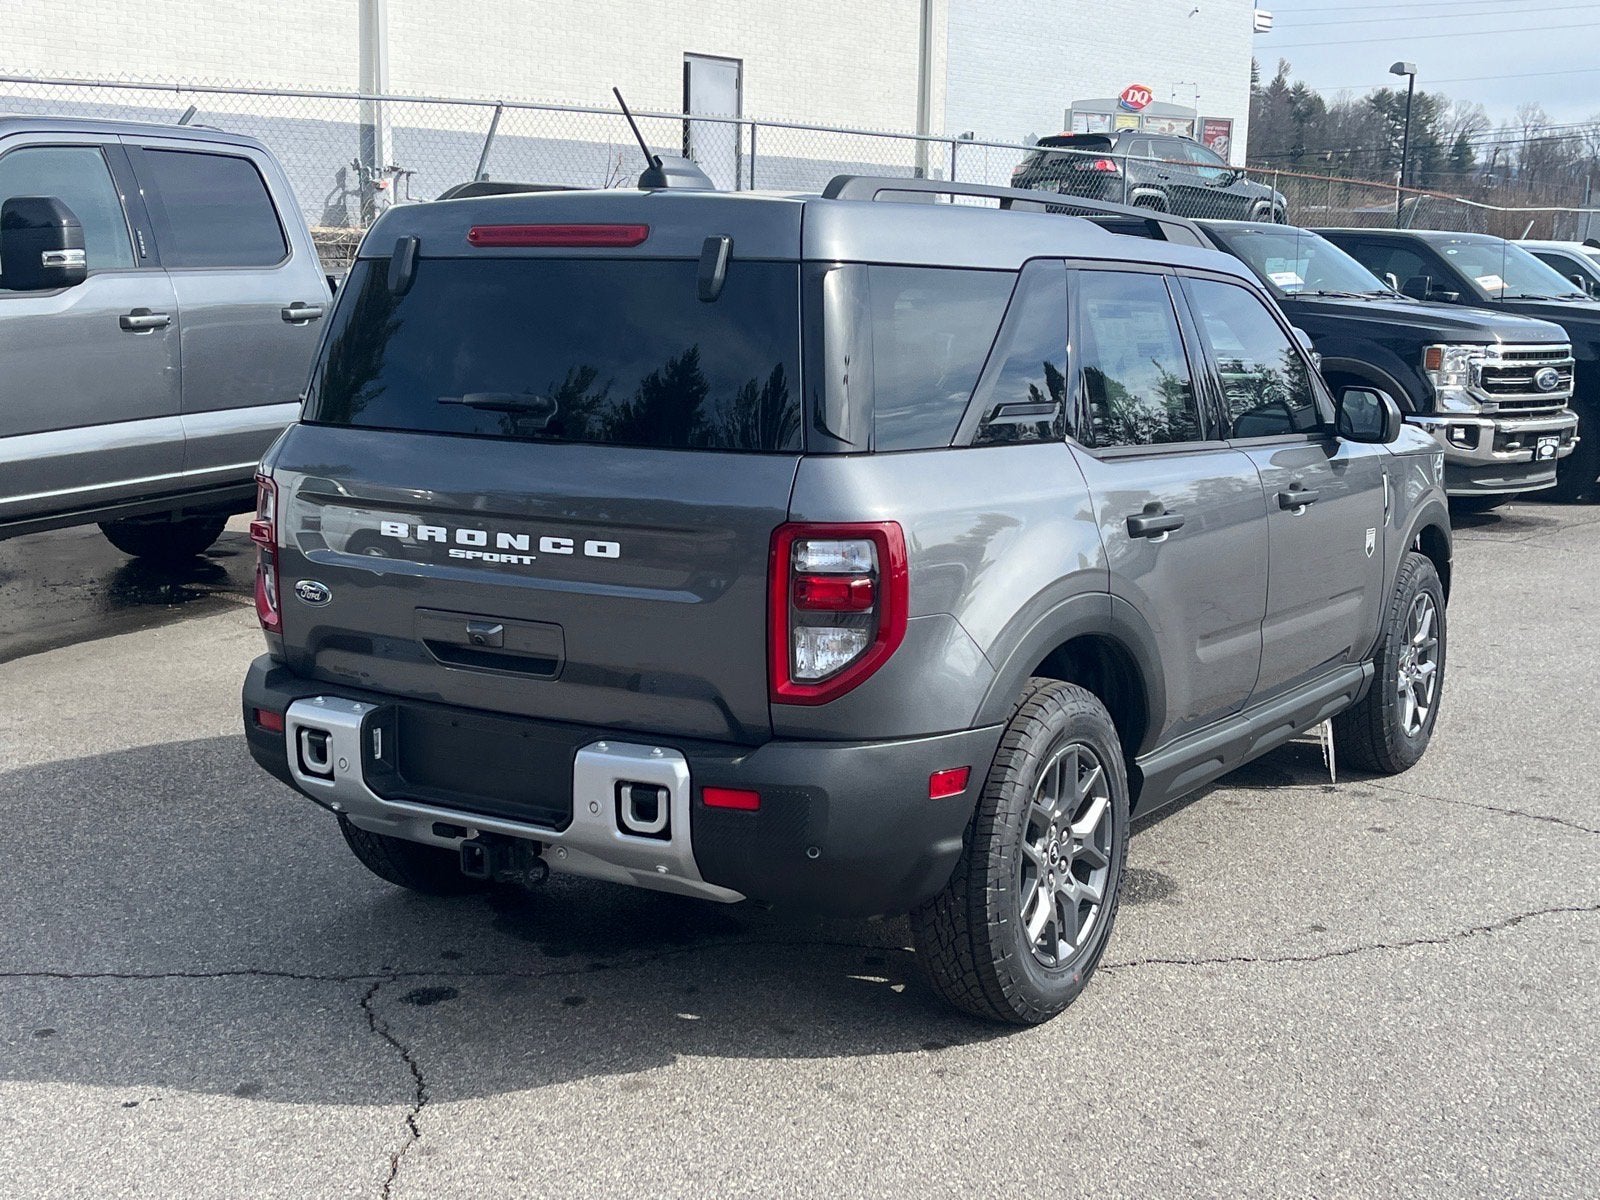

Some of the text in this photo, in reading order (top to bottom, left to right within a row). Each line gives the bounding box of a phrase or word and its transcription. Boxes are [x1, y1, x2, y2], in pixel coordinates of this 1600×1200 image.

[1126, 89, 1149, 106] DQ
[380, 521, 620, 559] BRONCO
[448, 549, 537, 565] SPORT
[300, 584, 322, 601] Ford
